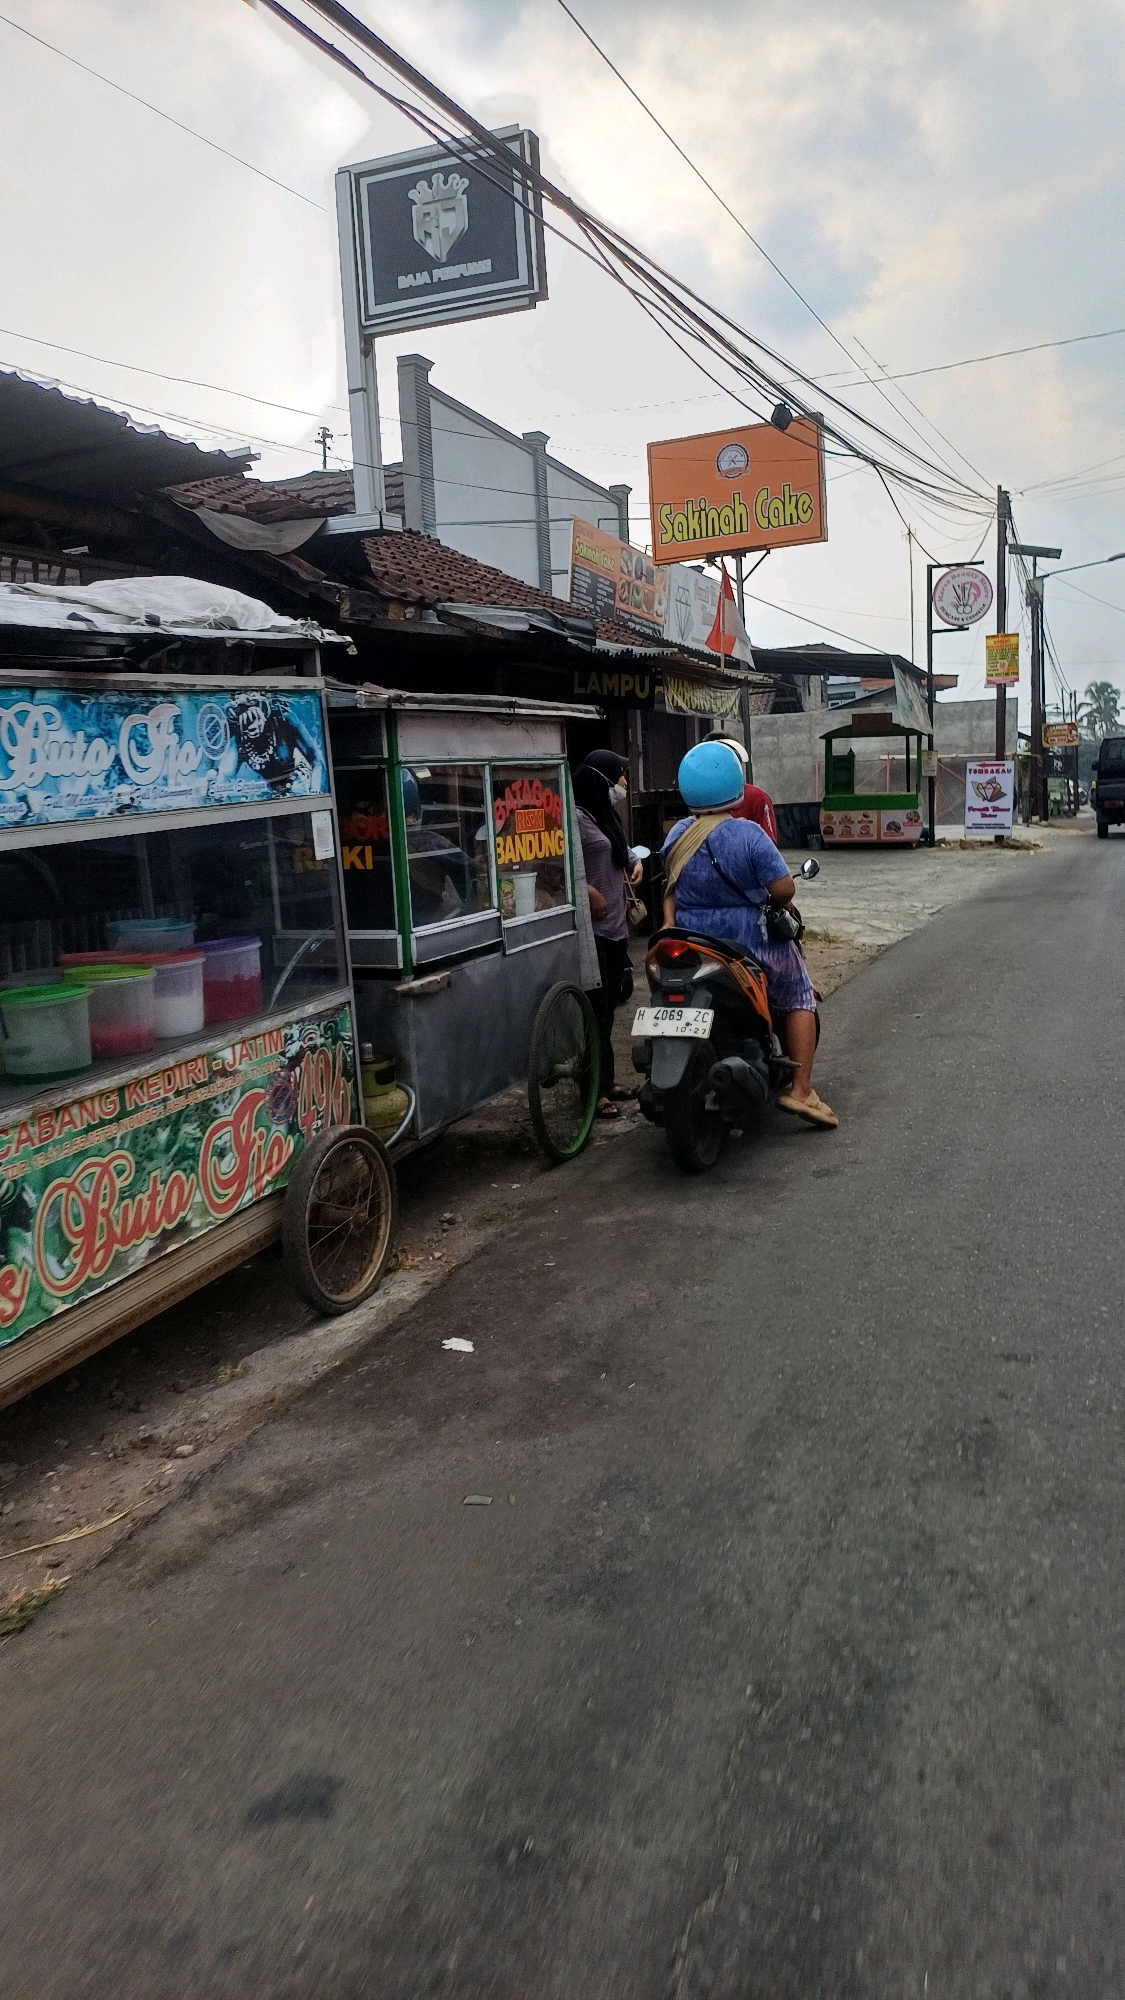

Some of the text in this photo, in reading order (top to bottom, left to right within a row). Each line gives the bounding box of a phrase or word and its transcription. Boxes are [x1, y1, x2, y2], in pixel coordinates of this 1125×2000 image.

[659, 483, 814, 545] Sakinah Cake
[950, 571, 978, 580] Beauty
[573, 670, 650, 699] LAMPU
[494, 778, 563, 834] BATAGOR
[496, 829, 565, 865] BANDUNG
[637, 1009, 710, 1023] H 4069 ZC
[0, 1092, 121, 1162] CABANG
[125, 1054, 208, 1112] KEDIRI
[224, 1027, 285, 1072] JATIM
[34, 1149, 198, 1294] Buto
